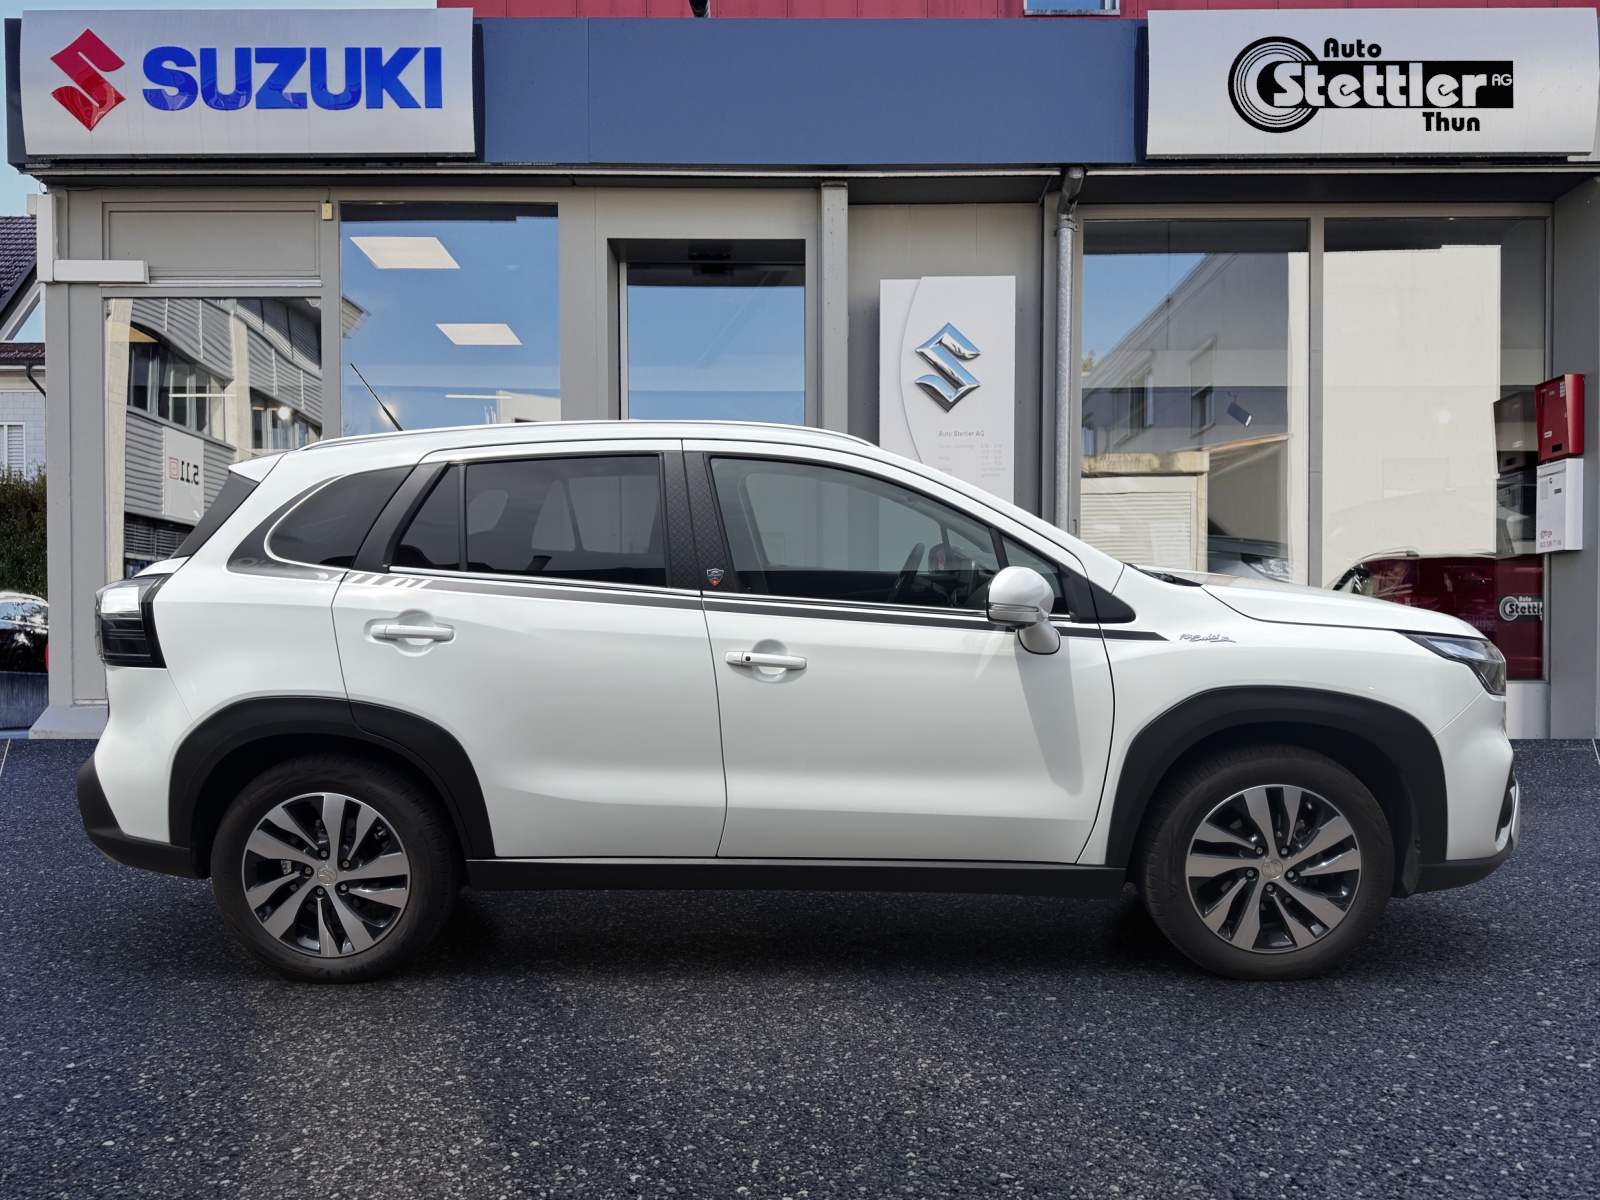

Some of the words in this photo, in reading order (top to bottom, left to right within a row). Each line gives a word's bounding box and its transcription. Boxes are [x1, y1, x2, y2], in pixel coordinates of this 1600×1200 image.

[1323, 37, 1382, 58] Auto
[142, 45, 443, 111] SUZUKI
[1273, 62, 1488, 107] Stettler
[1491, 73, 1513, 87] AG
[1422, 111, 1481, 132] Thun
